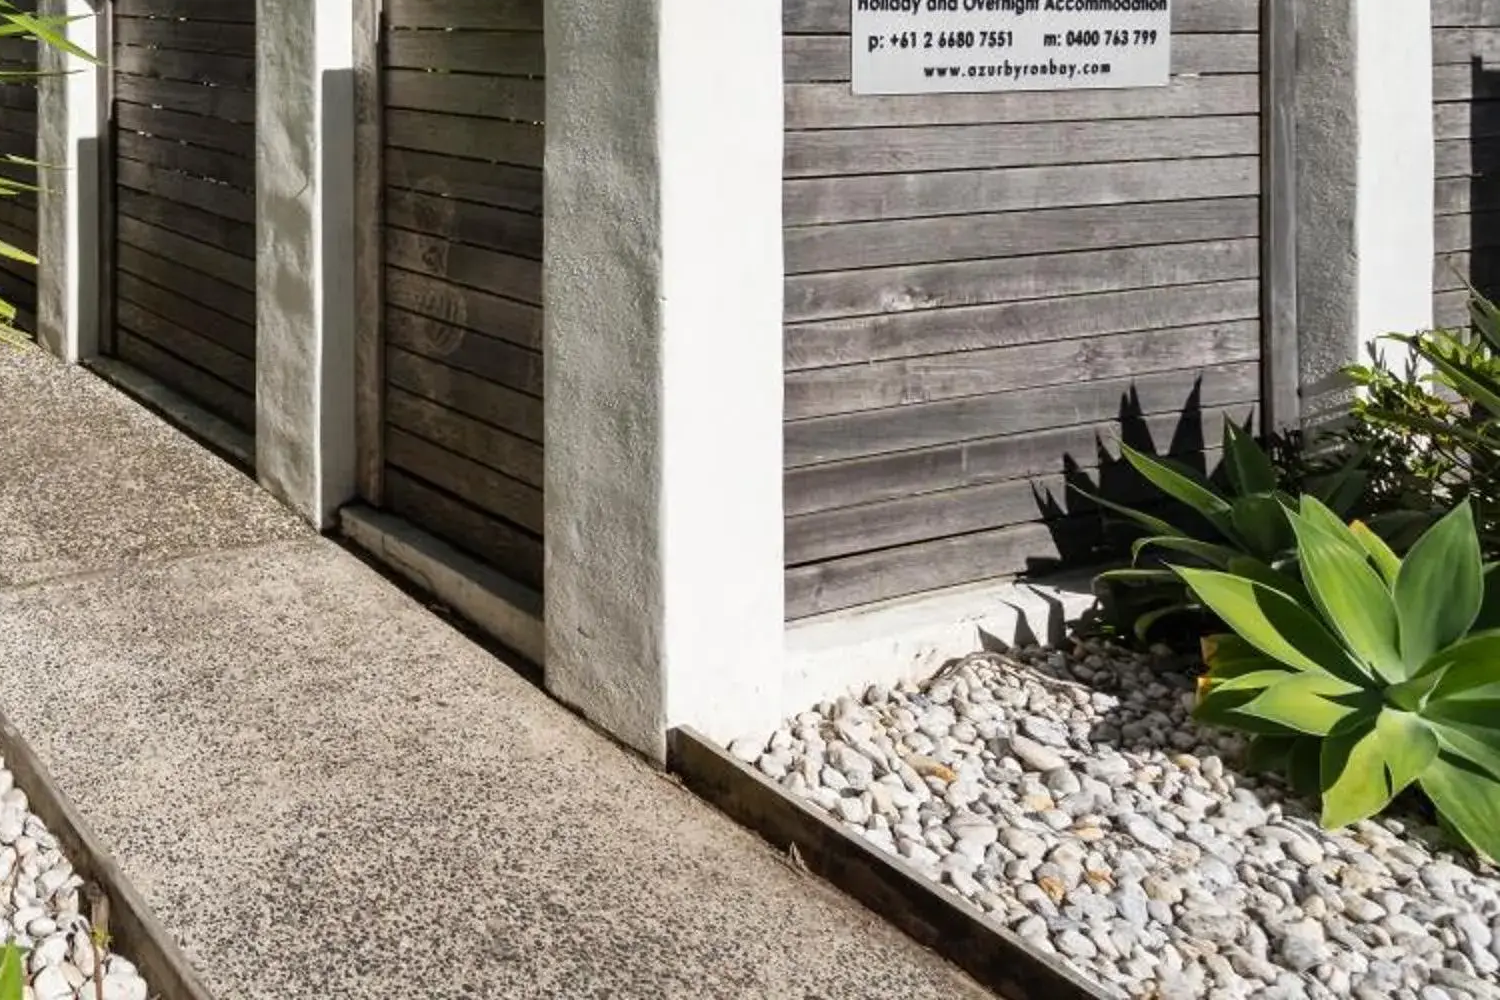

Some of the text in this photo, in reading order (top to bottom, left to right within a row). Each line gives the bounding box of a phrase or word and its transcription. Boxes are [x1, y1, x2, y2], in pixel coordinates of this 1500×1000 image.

[867, 29, 1157, 53] p: +61 2 6680 7551 m: 0400 763 799
[923, 59, 1112, 80] www.azurbyronbay.com
